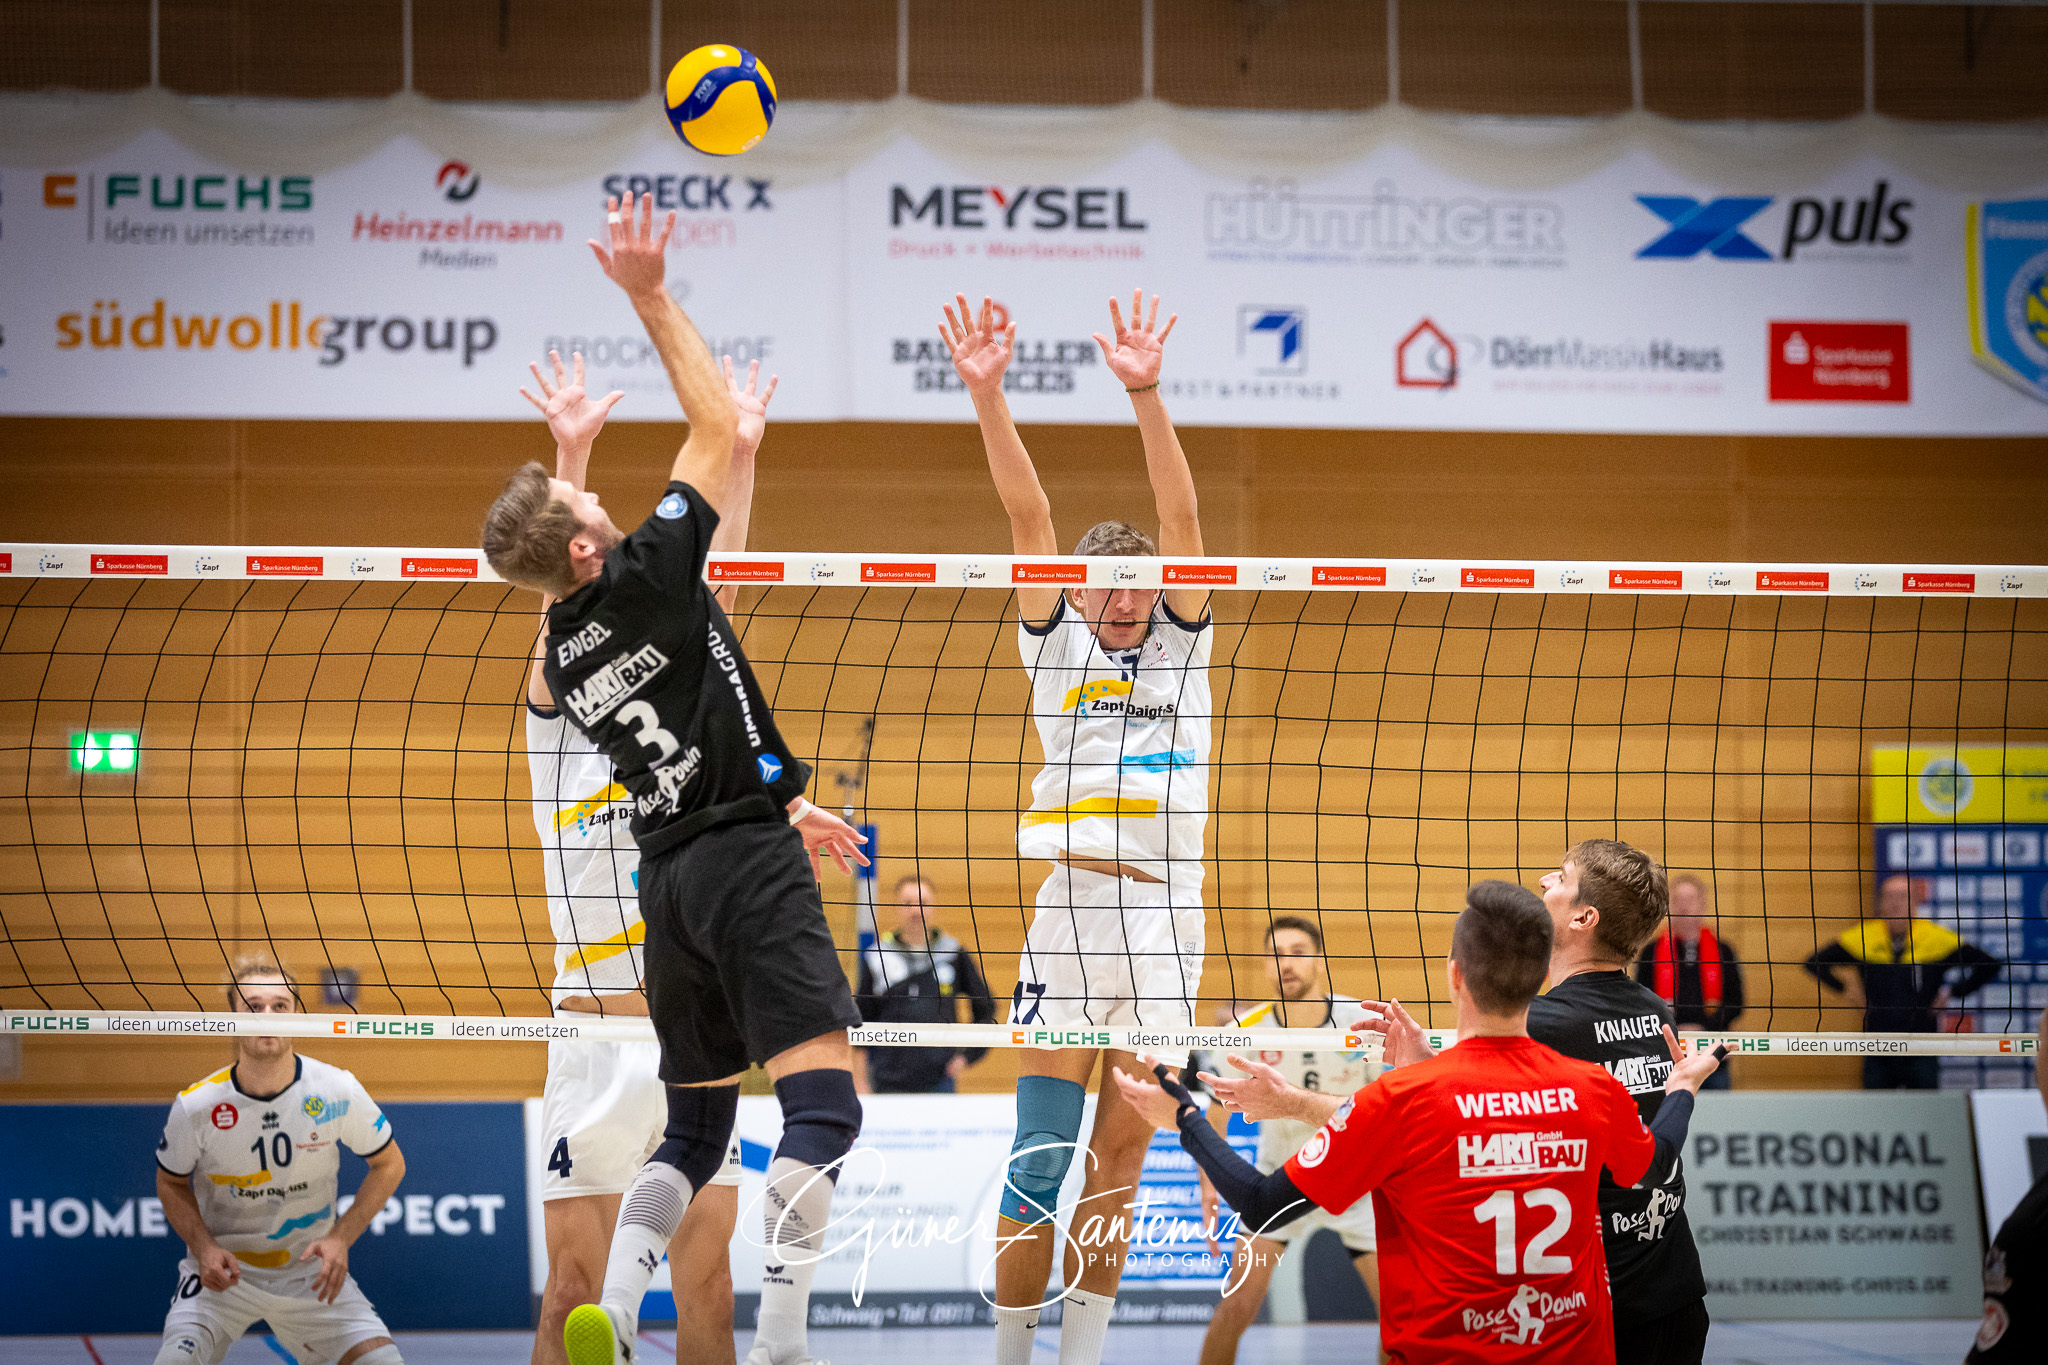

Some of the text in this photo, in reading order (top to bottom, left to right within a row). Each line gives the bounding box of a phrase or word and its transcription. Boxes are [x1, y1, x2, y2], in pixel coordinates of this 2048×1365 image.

[106, 174, 314, 212] FUCHS
[603, 174, 732, 211] SPECK
[890, 184, 1147, 231] MEYSEL
[352, 211, 564, 245] Heinzelmann
[1783, 180, 1913, 262] puls
[104, 216, 315, 248] Ideen umsetzen
[419, 248, 498, 269] Medien
[46, 562, 63, 570] Zapf
[107, 563, 163, 571] Sparkasse Nürnberg
[202, 564, 219, 572] Zapf
[262, 564, 318, 572] Sparkasse Nürnberg
[357, 565, 374, 573] Zapf
[446, 566, 472, 574] Nürnberg
[724, 569, 779, 578] Sparkasse Nürnberg
[817, 571, 834, 579] Zapf
[904, 571, 930, 579] Nürnberg
[969, 572, 986, 580] Zapf
[1055, 572, 1081, 580] Nürnberg
[1120, 573, 1137, 581] Zapf
[1206, 573, 1232, 581] Nürnberg
[1270, 574, 1286, 582] Zapf
[1355, 575, 1381, 583] Nürnberg
[1418, 576, 1435, 584] Zapf
[1476, 576, 1530, 585] Sparkasse Nürnberg
[1567, 577, 1583, 585] Zapf
[1652, 578, 1678, 586] Nürnberg
[1799, 580, 1824, 588] Nürnberg
[1945, 581, 1970, 589] Nürnberg
[2006, 582, 2023, 590] Zapf
[557, 621, 612, 668] ENGEL
[620, 649, 662, 688] BAU
[565, 663, 625, 721] HART
[615, 700, 680, 771] 3
[589, 808, 616, 827] Zapf
[11, 1016, 236, 1033] FUCHS Ideen umsetzen
[357, 1021, 434, 1035] FUCHS
[452, 1022, 495, 1037] Ideen
[501, 1023, 579, 1038] umsetzen
[1594, 1014, 1664, 1044] KNAUER
[851, 1029, 917, 1043] msetzen
[1035, 1031, 1110, 1045] FUCHS
[1127, 1031, 1170, 1046] Ideen
[1176, 1033, 1252, 1047] umsetzen
[1787, 1038, 1827, 1052] Ideen
[1834, 1039, 1908, 1053] umsetzen
[1455, 1087, 1579, 1119] WERNER
[251, 1132, 292, 1171] 10
[548, 1137, 573, 1178] 4
[1458, 1131, 1586, 1169] HART GmbH BAU
[1692, 1132, 1946, 1168] PERSONAL
[1704, 1180, 1942, 1216] TRAINING
[10, 1198, 168, 1238] HOME
[1612, 1212, 1646, 1234] Pose
[1473, 1188, 1573, 1275] 12
[1463, 1308, 1508, 1331] Pose
[1540, 1290, 1587, 1319] Down
